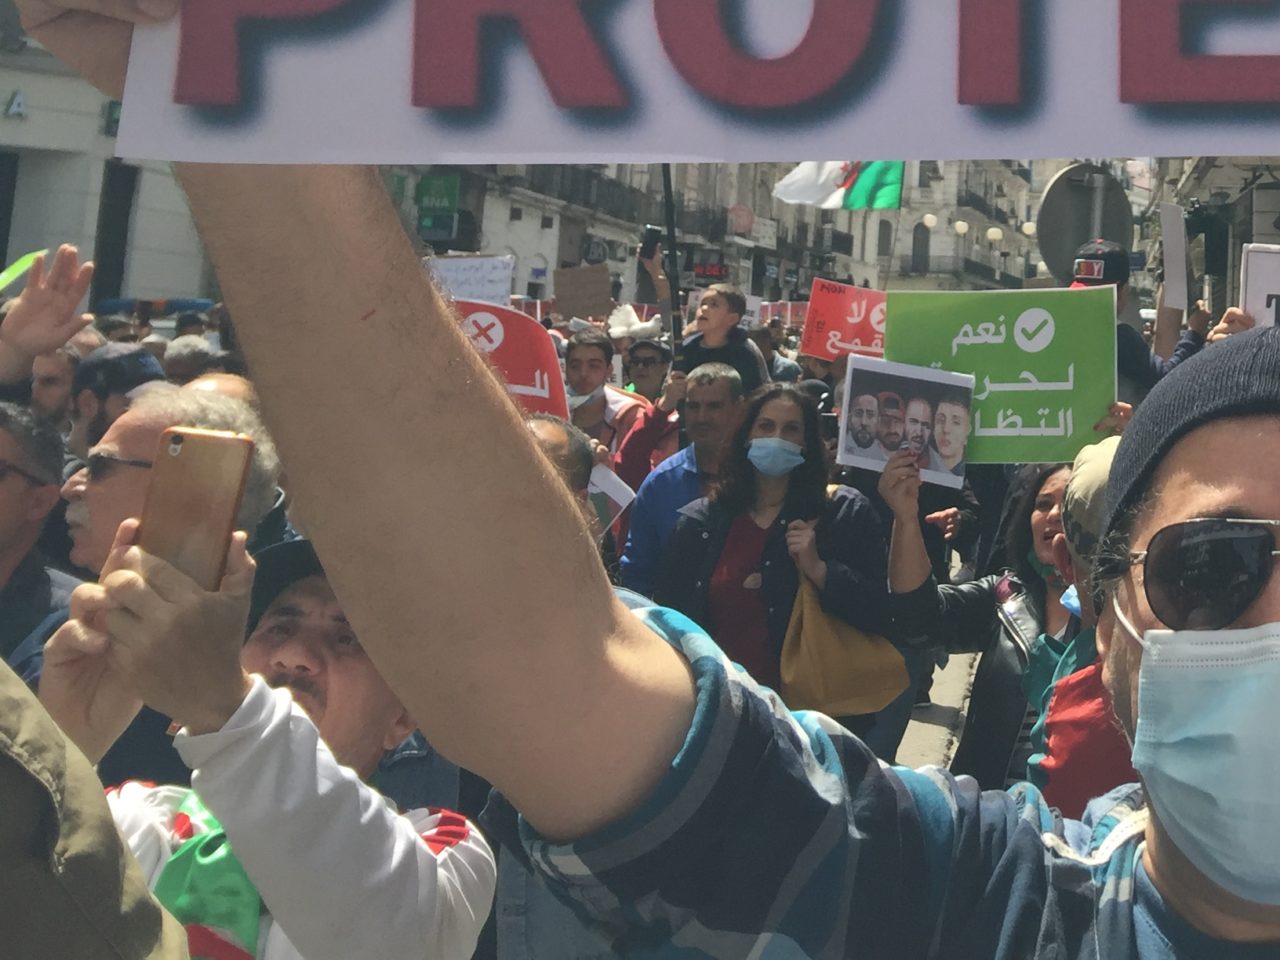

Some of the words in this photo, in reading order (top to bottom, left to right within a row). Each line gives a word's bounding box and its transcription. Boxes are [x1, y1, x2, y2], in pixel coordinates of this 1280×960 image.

[826, 330, 885, 355] قمع
[952, 315, 1006, 356] نعم
[975, 407, 1073, 438] التظا
